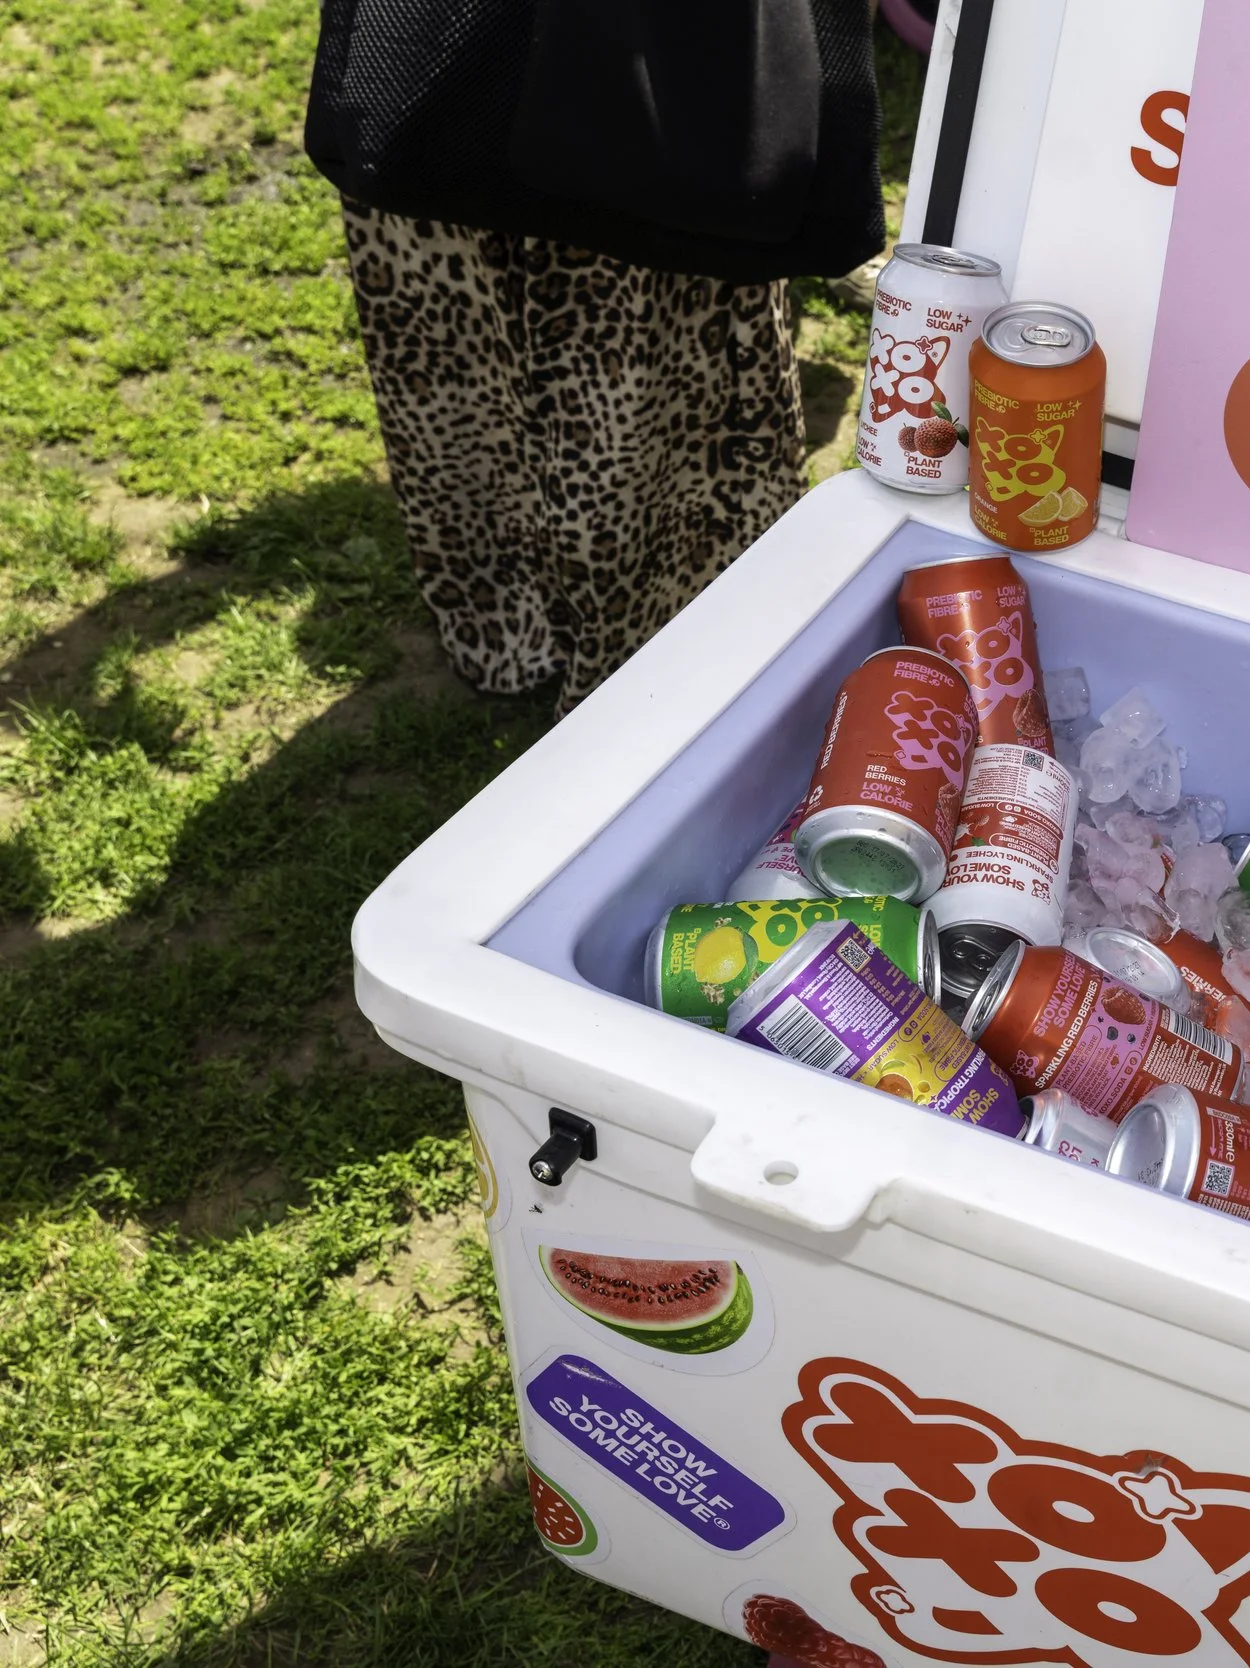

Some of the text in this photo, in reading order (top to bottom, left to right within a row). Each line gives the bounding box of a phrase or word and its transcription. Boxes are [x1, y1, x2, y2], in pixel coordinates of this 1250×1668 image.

[876, 289, 912, 311] PREBIOTIC
[876, 302, 890, 315] FIBRE
[927, 307, 952, 320] LOW
[926, 319, 963, 333] SUGAR
[975, 379, 1019, 409] PREBIOTIC
[975, 391, 995, 411] FIBRE
[1036, 409, 1075, 421] SUGAR
[1037, 403, 1063, 412] LOW
[906, 466, 941, 479] BASED
[908, 456, 942, 469] PLANT
[974, 492, 998, 513] ORANGE
[974, 504, 989, 523] LOW
[974, 516, 1007, 541] CALORIE
[1035, 526, 1068, 538] PLANT
[1034, 535, 1069, 546] BASED
[926, 586, 1016, 607] PREBIOTIC LOW
[928, 606, 956, 618] FIBRE
[894, 669, 928, 684] FIBRE
[895, 661, 954, 687] PREBIOTIC
[820, 695, 848, 770] RED BERRIES
[865, 772, 906, 786] BERRIES
[867, 764, 887, 773] RED
[863, 782, 892, 794] LOW
[860, 791, 913, 812] CALORIE
[966, 851, 1005, 859] LYCHEE
[970, 863, 1011, 875] SOME
[1006, 854, 1053, 883] SPARKLING
[980, 874, 1025, 891] SHOW
[670, 933, 684, 974] BASED
[683, 932, 697, 971] PLANT
[1053, 962, 1086, 1028] SOME LOVE
[1034, 1004, 1057, 1038] SHOW
[867, 1017, 899, 1050] INGREDIENTS
[1034, 1038, 1072, 1088] SPARKLING
[1067, 1017, 1084, 1043] RED
[1078, 980, 1098, 1020] BERRIES
[868, 1038, 899, 1070] LOW SUGAR
[1143, 1034, 1162, 1072] INGREDIENTS
[968, 1088, 999, 1124] SHOW
[549, 1396, 639, 1466] SOME
[580, 1394, 734, 1510] YOURSELF
[620, 1408, 718, 1477] SHOW
